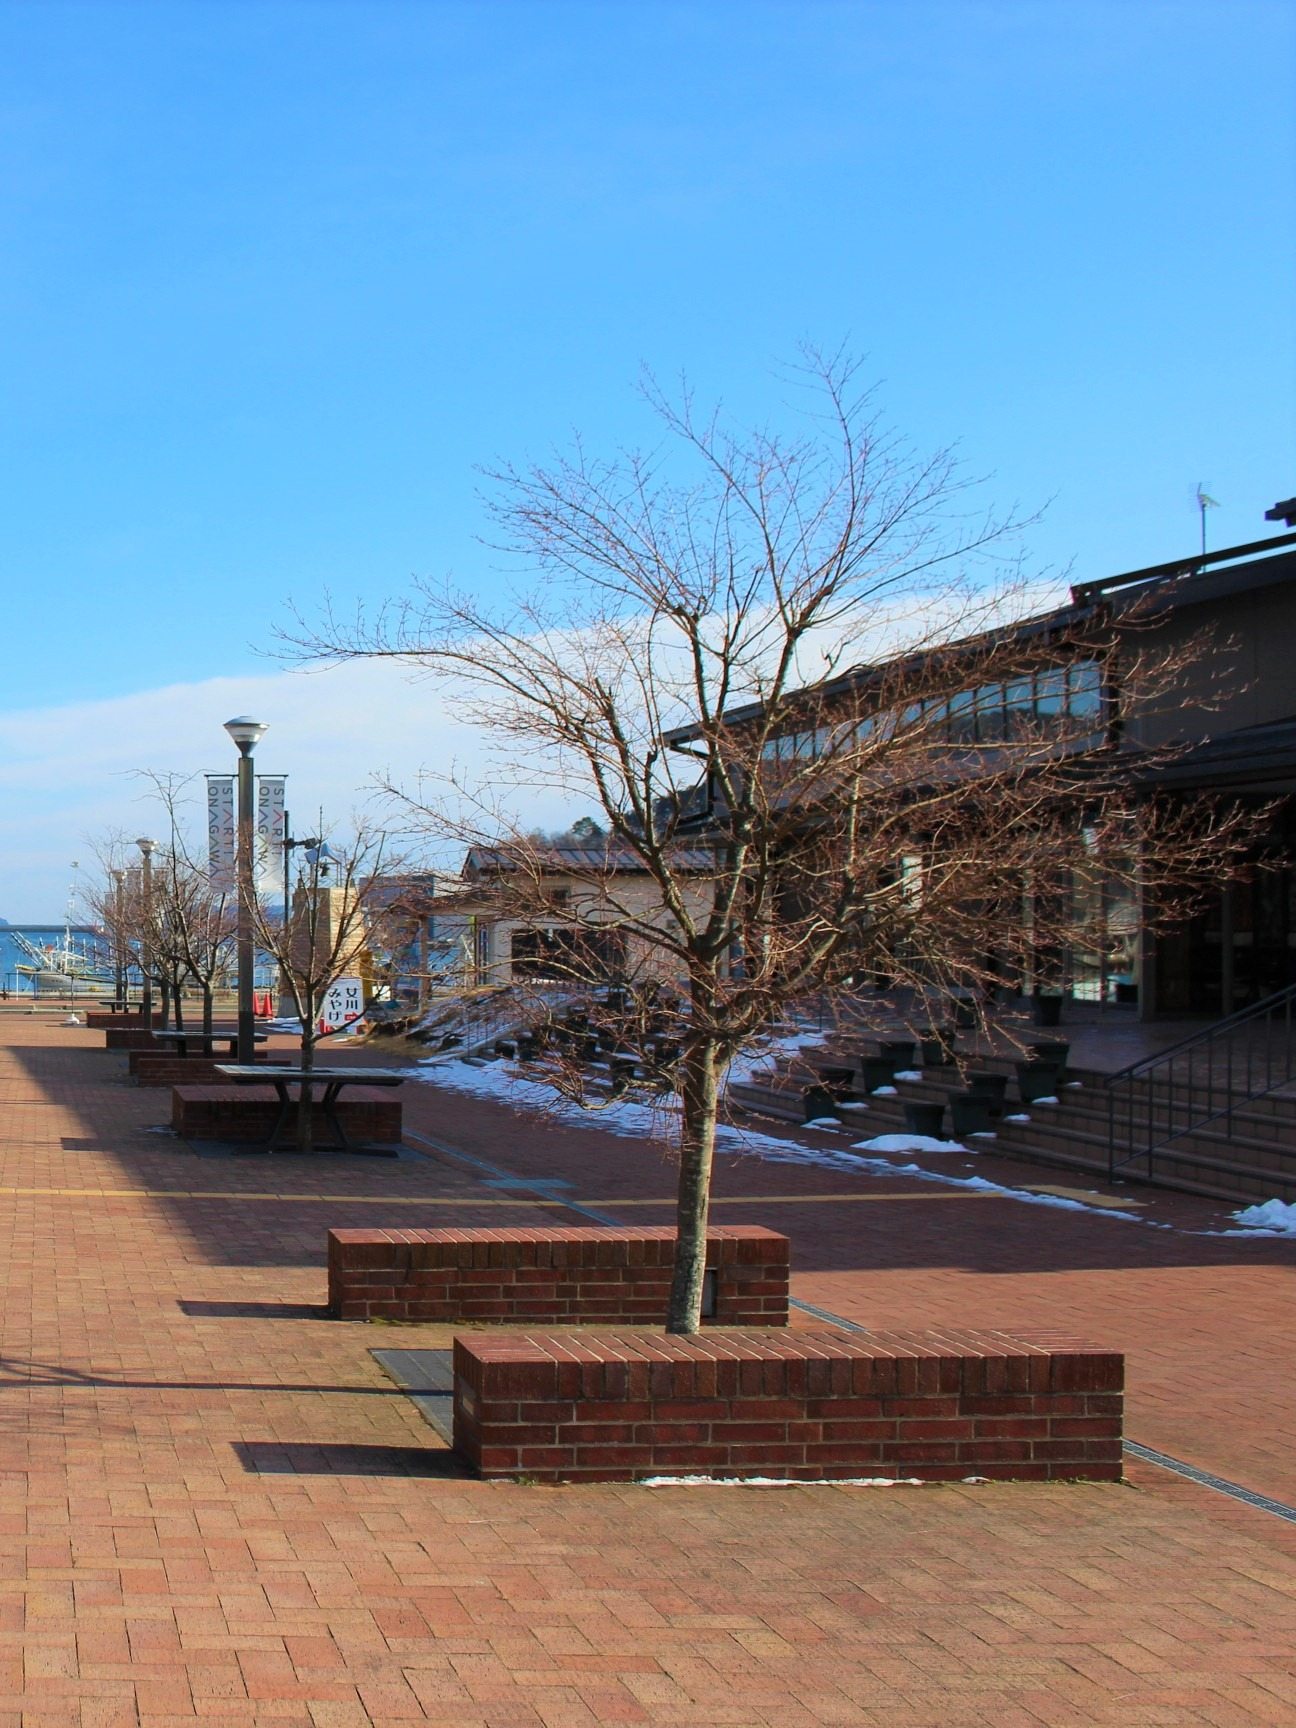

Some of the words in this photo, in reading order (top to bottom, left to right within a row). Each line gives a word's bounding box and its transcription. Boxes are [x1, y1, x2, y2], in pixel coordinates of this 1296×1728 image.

[222, 787, 234, 854] START!
[328, 988, 342, 1022] みやげ
[345, 987, 358, 1010] 女川
